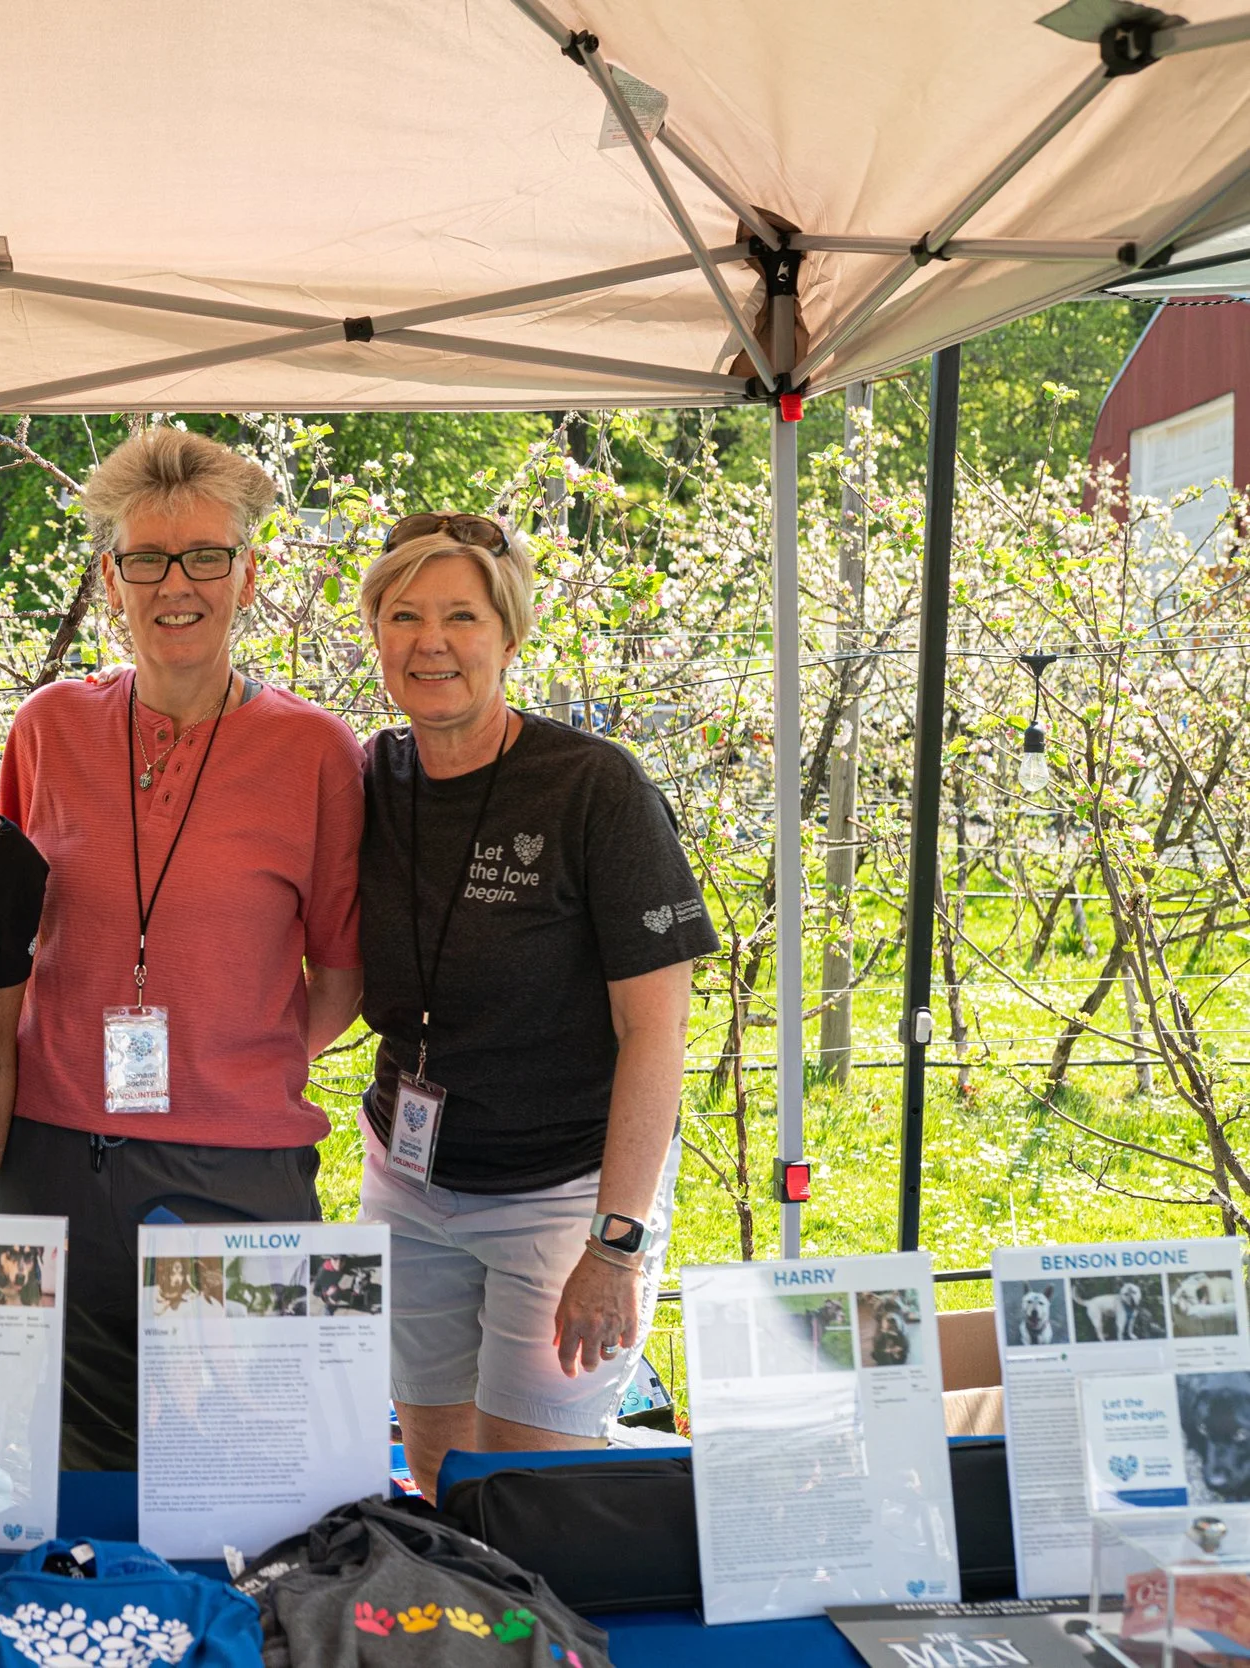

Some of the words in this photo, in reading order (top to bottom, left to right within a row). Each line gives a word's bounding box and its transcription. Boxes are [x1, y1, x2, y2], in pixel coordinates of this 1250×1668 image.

[474, 842, 504, 861] Let
[469, 863, 498, 881] the
[503, 866, 540, 886] love
[464, 882, 518, 903] begin.
[392, 1156, 426, 1174] VOLUNTEER
[225, 1234, 301, 1249] WILLOW
[1041, 1253, 1117, 1271] BENSON
[1122, 1250, 1189, 1267] BOONE
[774, 1268, 837, 1287] HARRY
[923, 1632, 962, 1643] THE
[887, 1638, 1032, 1668] MAN
